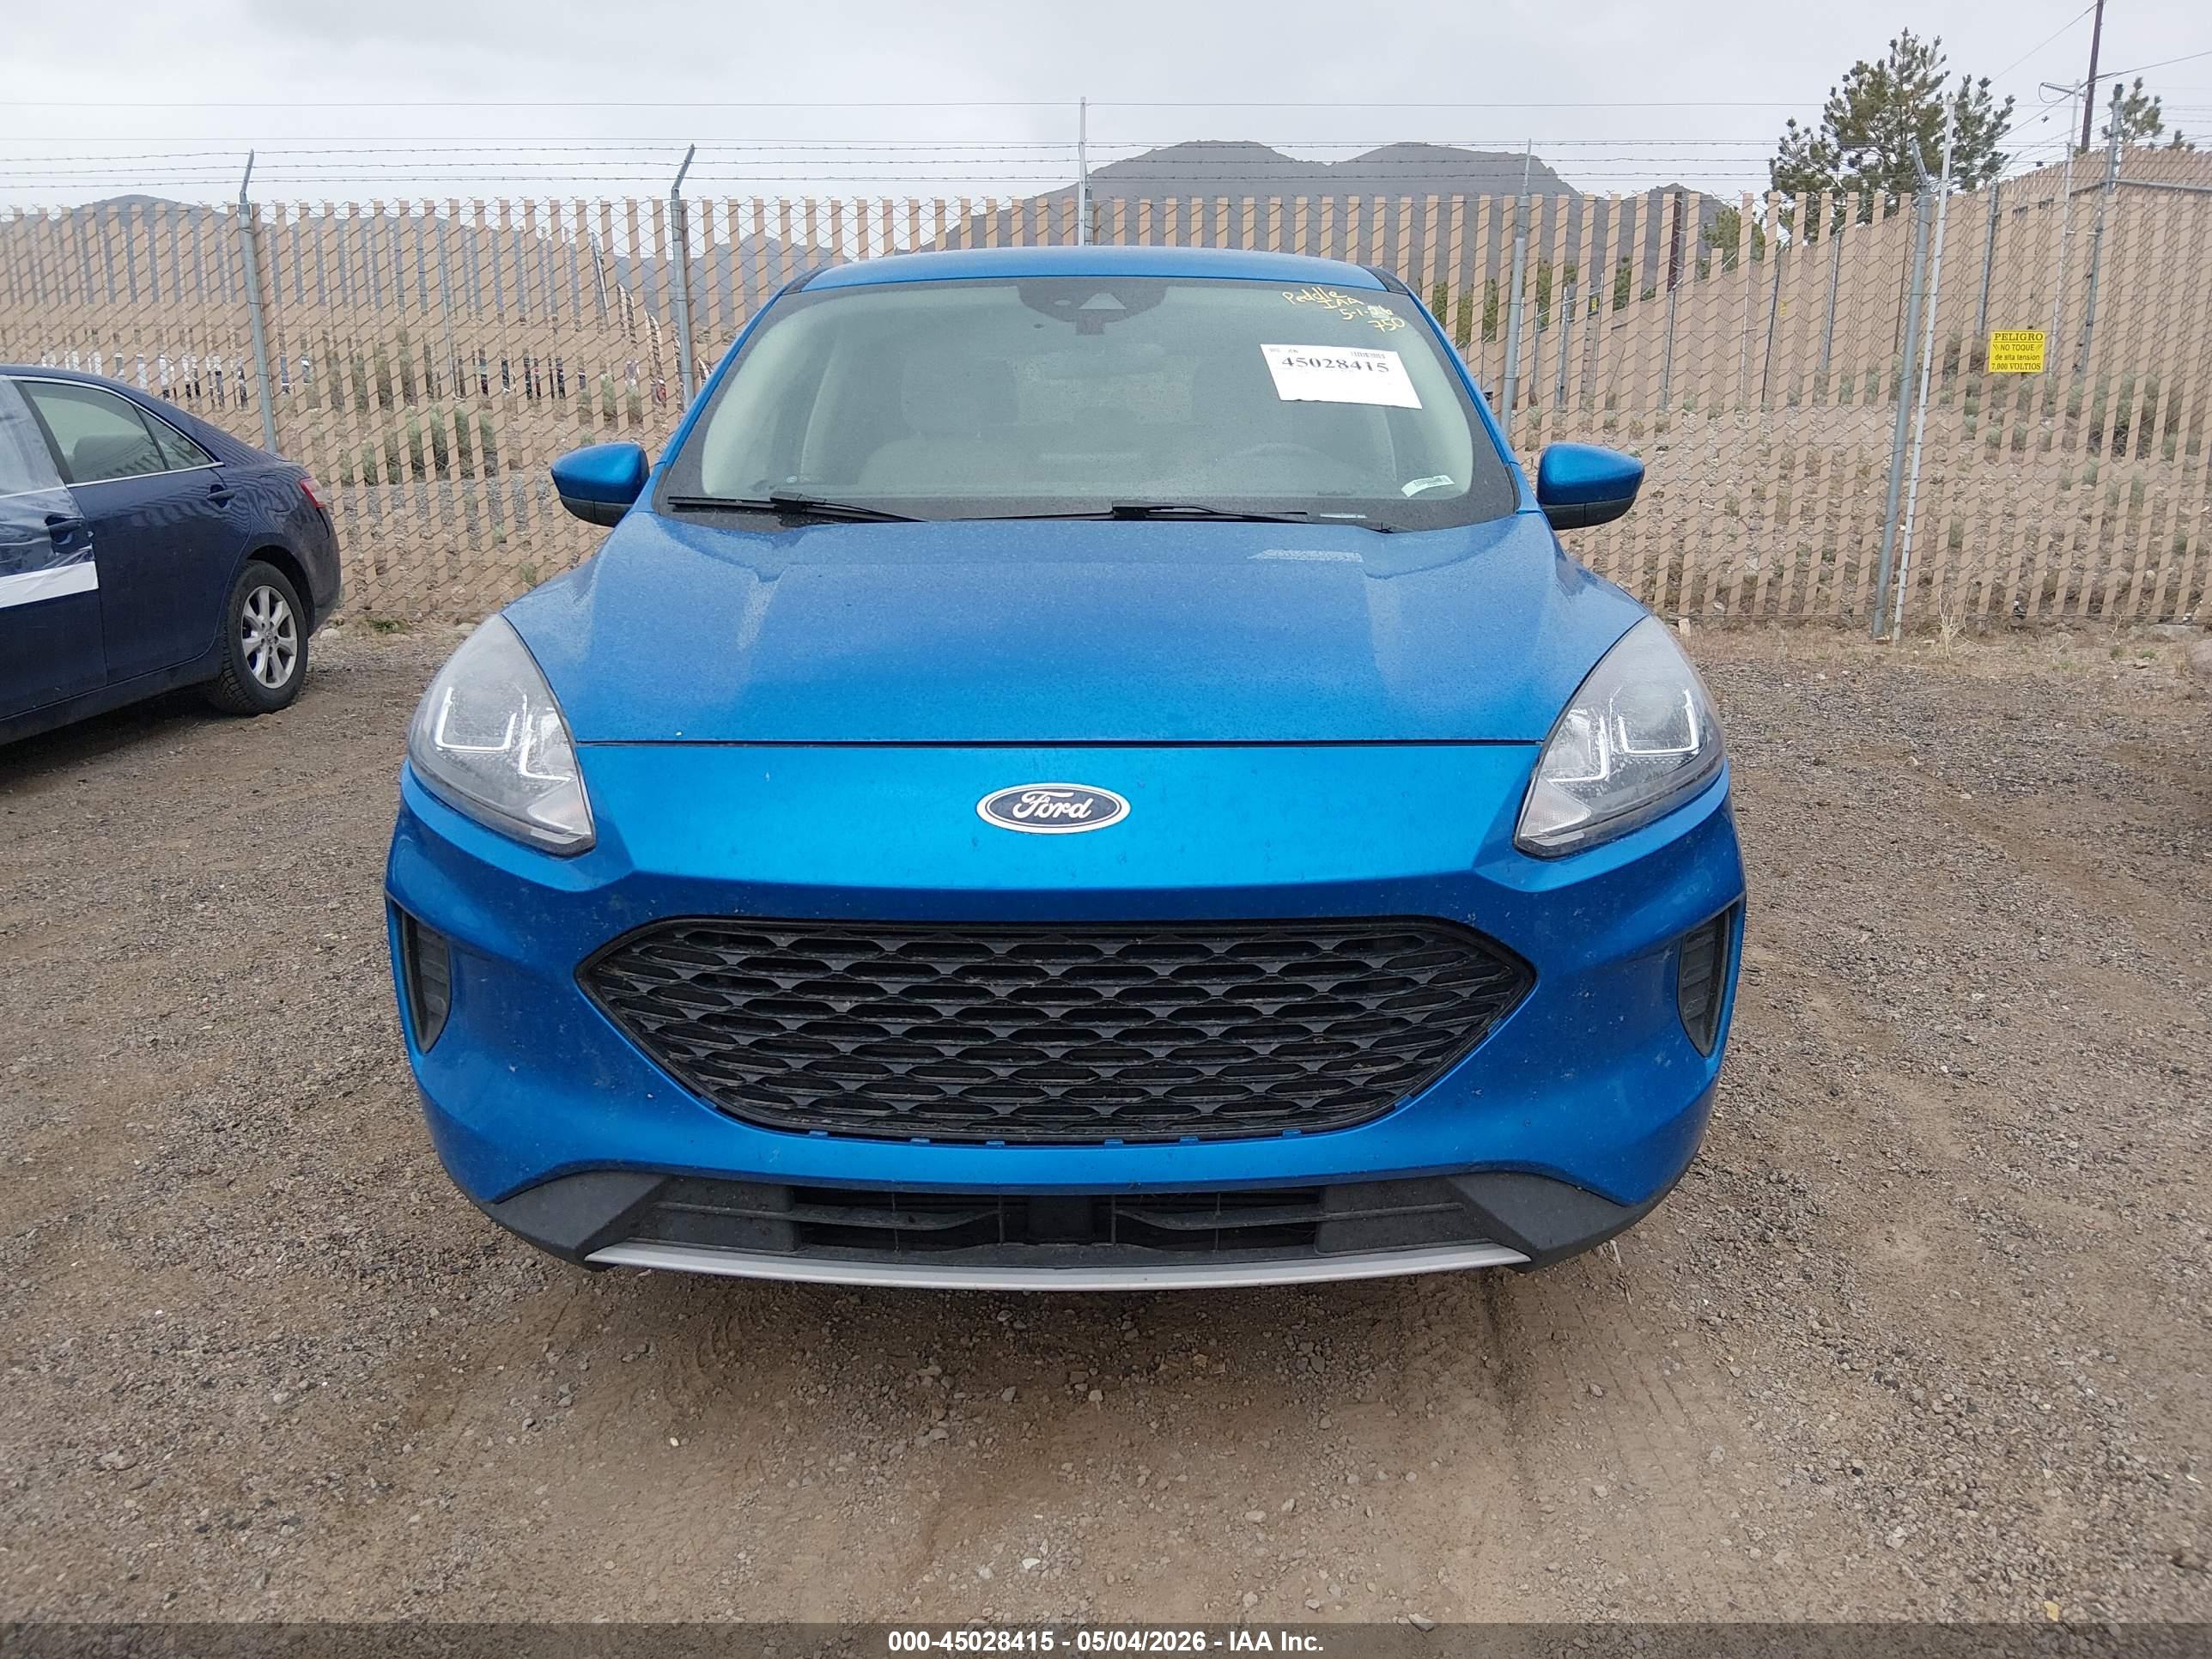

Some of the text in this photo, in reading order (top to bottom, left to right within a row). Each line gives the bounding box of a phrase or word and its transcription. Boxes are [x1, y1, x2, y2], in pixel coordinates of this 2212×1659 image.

[1282, 287, 1348, 305] Peddle
[1316, 297, 1364, 310] IAA
[1994, 332, 2044, 341] PELIGRO
[1281, 356, 1389, 373] 45028415
[1991, 362, 2041, 371] 7,000 VOLTIOS
[1012, 790, 1095, 819] Ford
